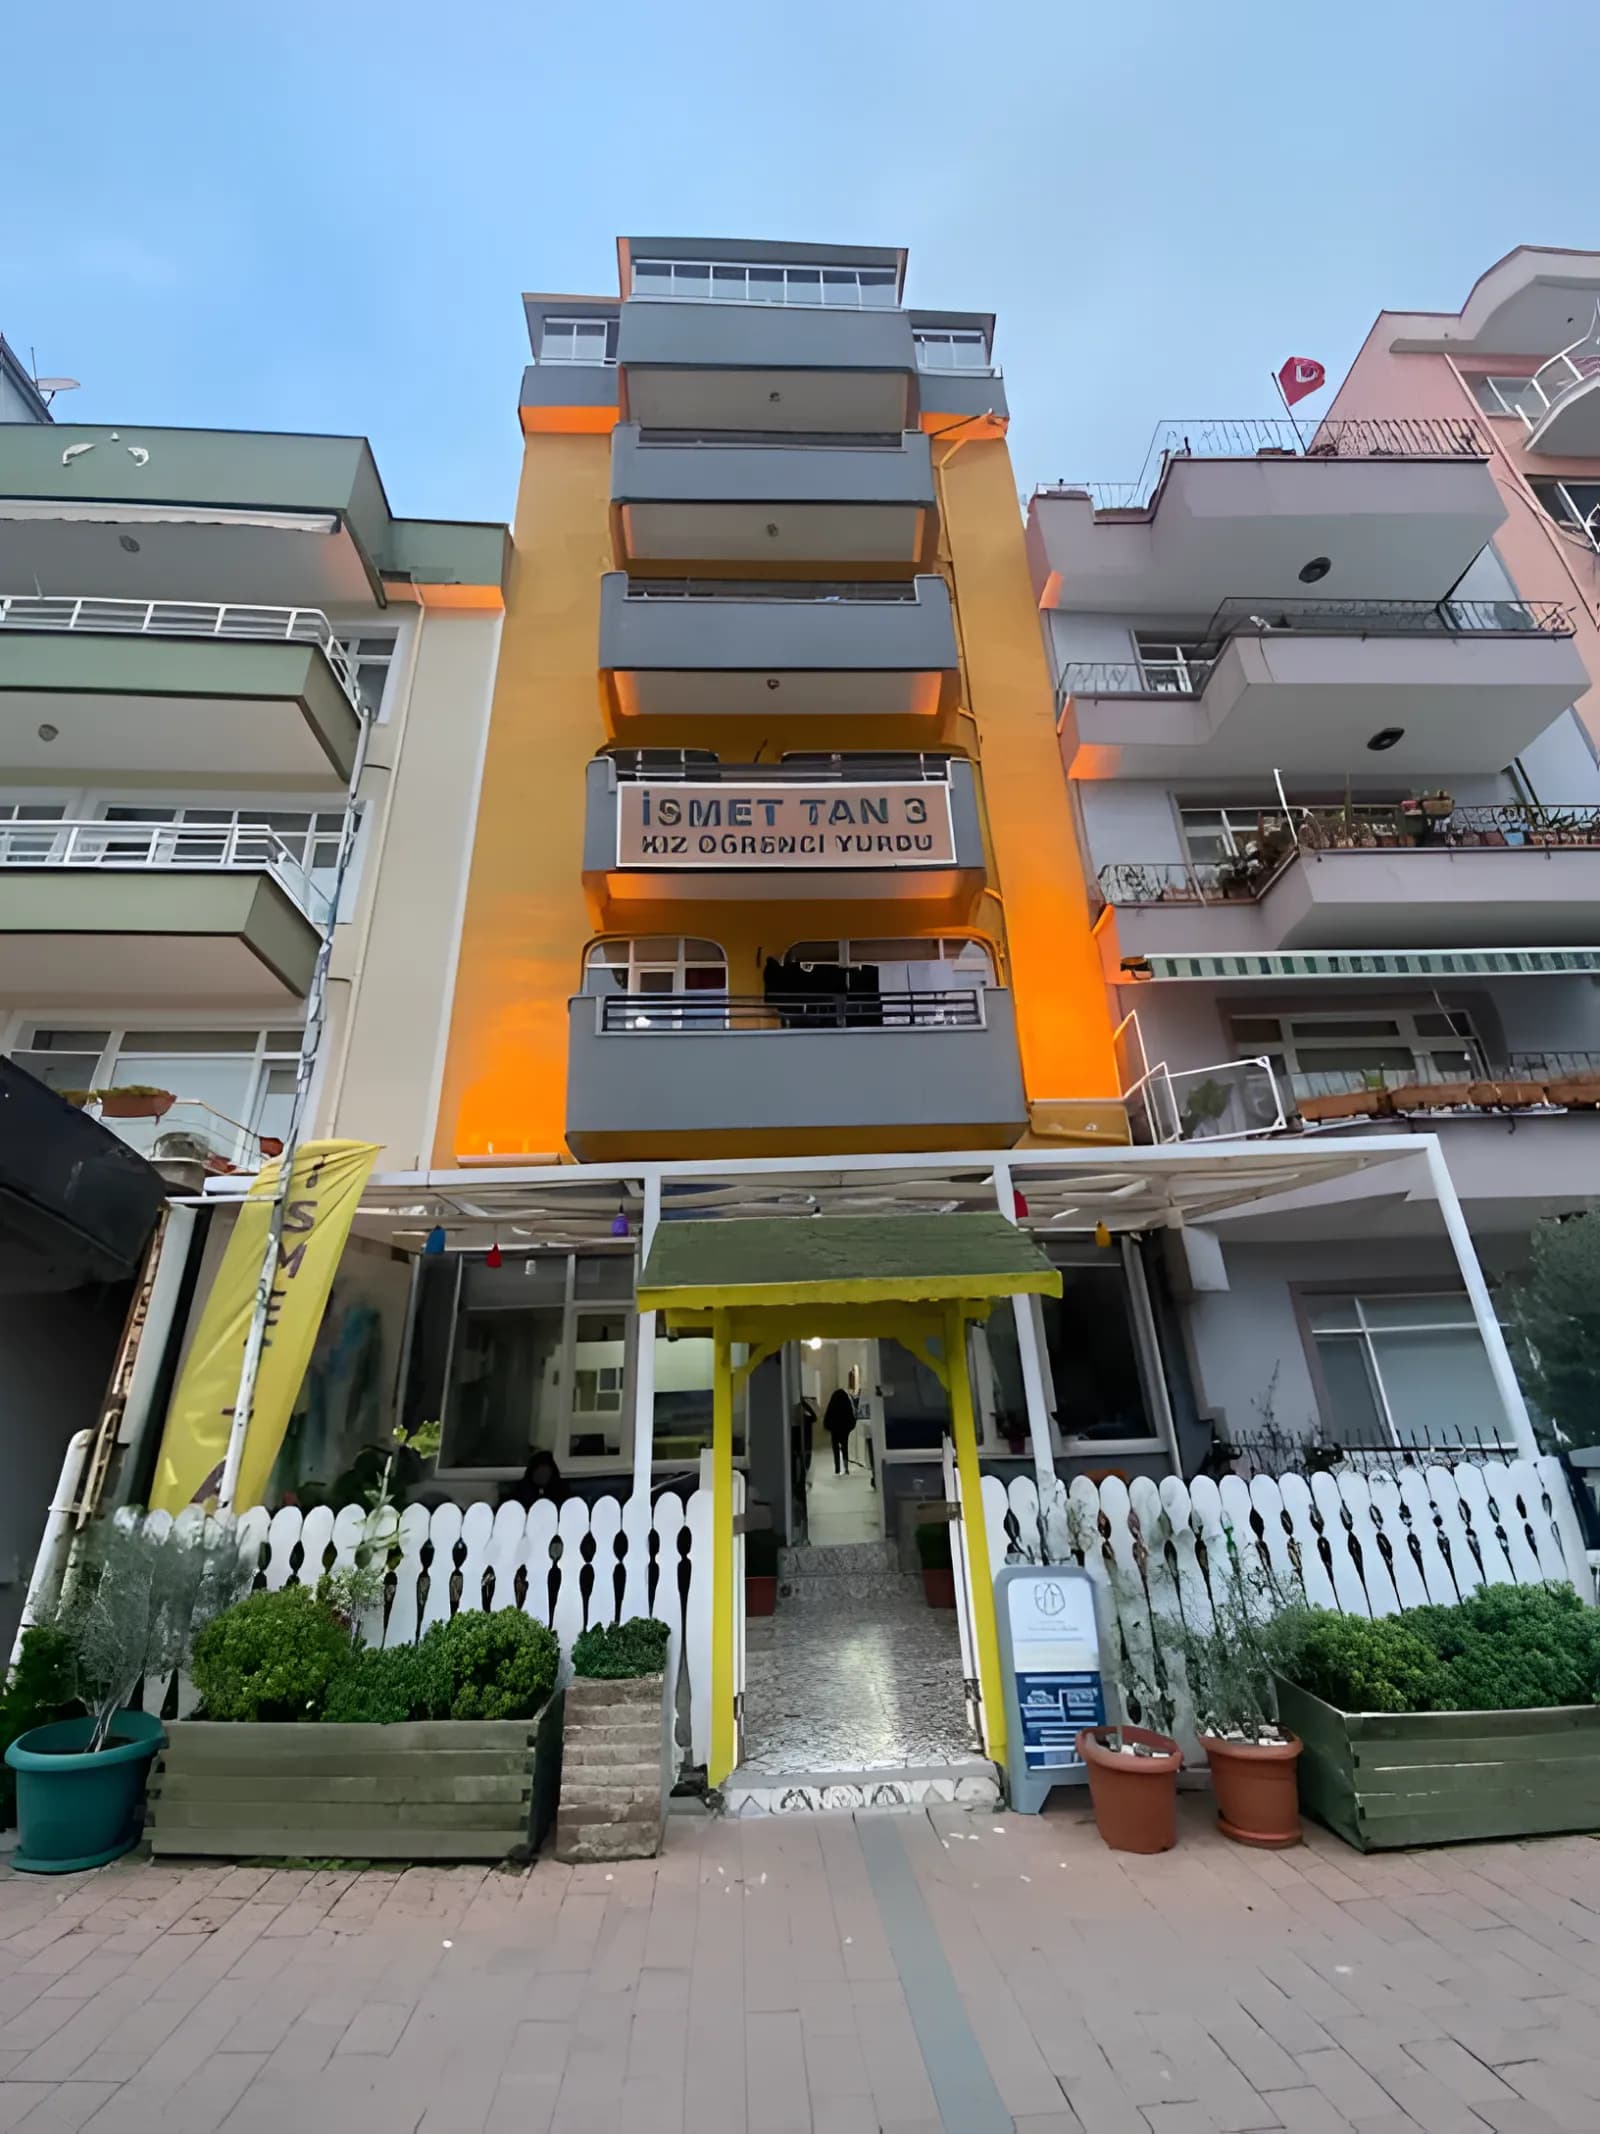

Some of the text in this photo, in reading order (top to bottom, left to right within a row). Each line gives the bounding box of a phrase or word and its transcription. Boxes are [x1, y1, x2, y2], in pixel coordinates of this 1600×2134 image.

[642, 790, 928, 827] İSMET TAN 3
[835, 834, 933, 853] YURDU
